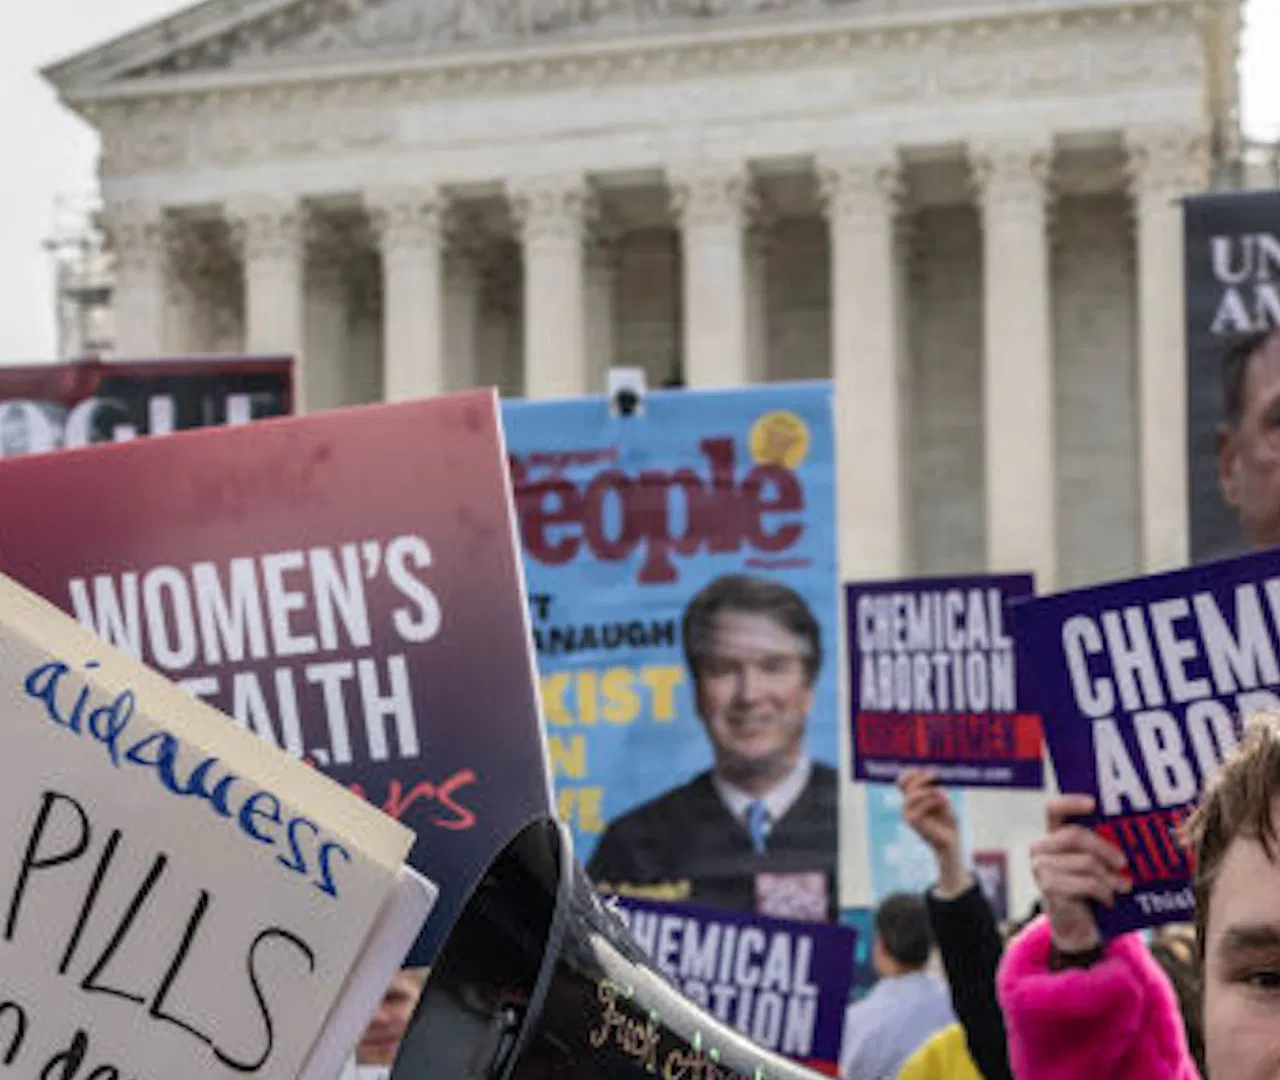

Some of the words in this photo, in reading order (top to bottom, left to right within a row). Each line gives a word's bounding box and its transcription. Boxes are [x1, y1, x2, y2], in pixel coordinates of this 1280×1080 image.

[857, 587, 1014, 652] CHEMICAL
[176, 653, 421, 765] ALTH
[859, 651, 1019, 714] ABORTION
[4, 790, 315, 1073] PILLS
